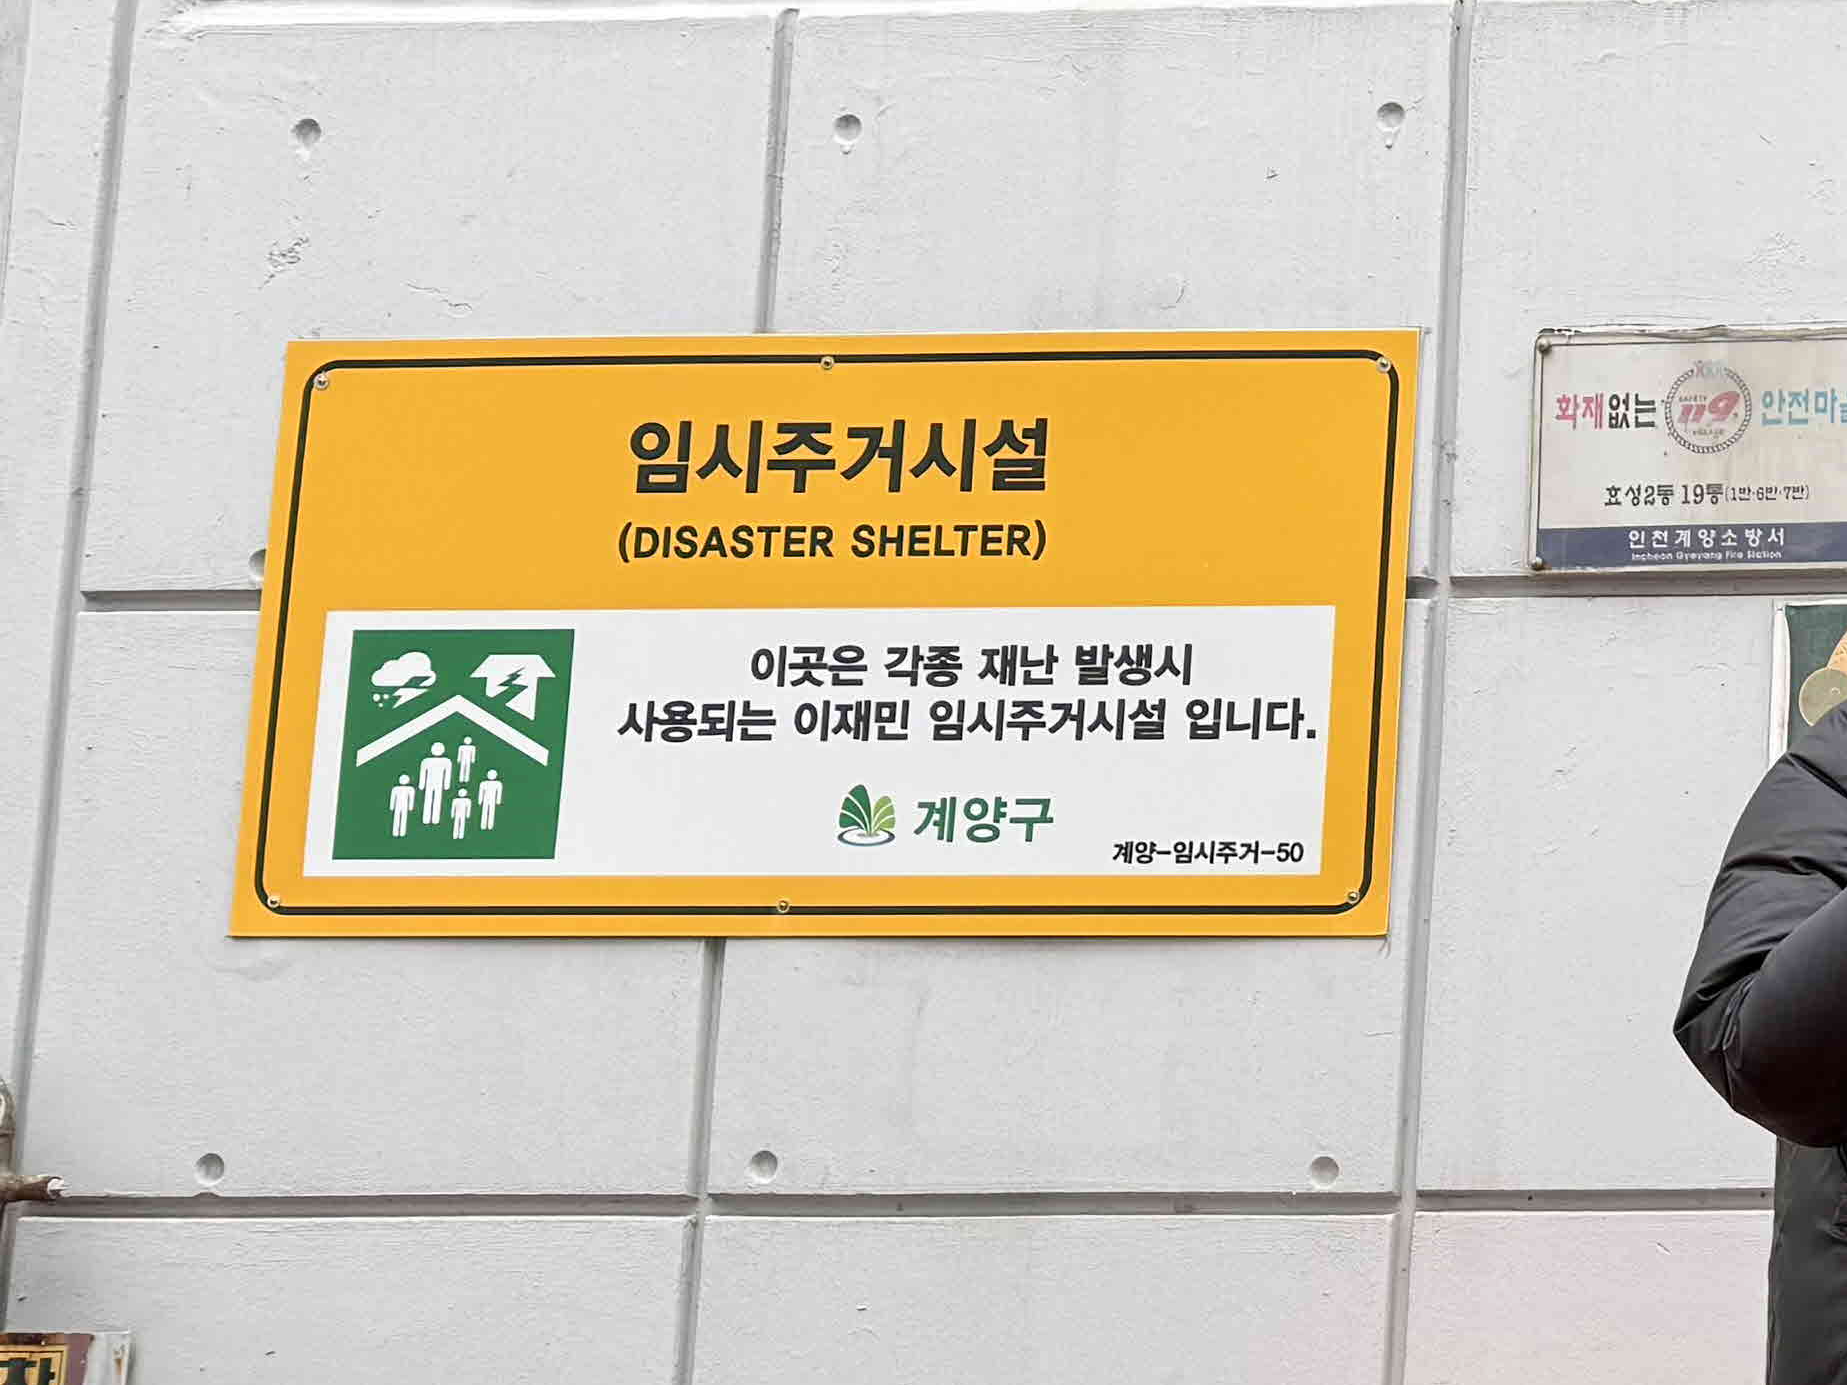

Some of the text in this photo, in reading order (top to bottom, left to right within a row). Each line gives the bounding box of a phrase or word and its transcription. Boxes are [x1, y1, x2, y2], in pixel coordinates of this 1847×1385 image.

[630, 417, 1048, 494] 임시주거시설
[1604, 483, 1675, 507] 효성2동
[618, 519, 1046, 564] (DISASTER SHELTER)
[1726, 550, 1744, 559] Fire
[751, 643, 1193, 688] 이곳은 각종 재난 발생시
[617, 697, 1317, 743] 사용되는 이재민 임시주거시설 입니다.
[914, 796, 1055, 844] 계양구
[1112, 840, 1304, 865] 계양-임시주거-50
